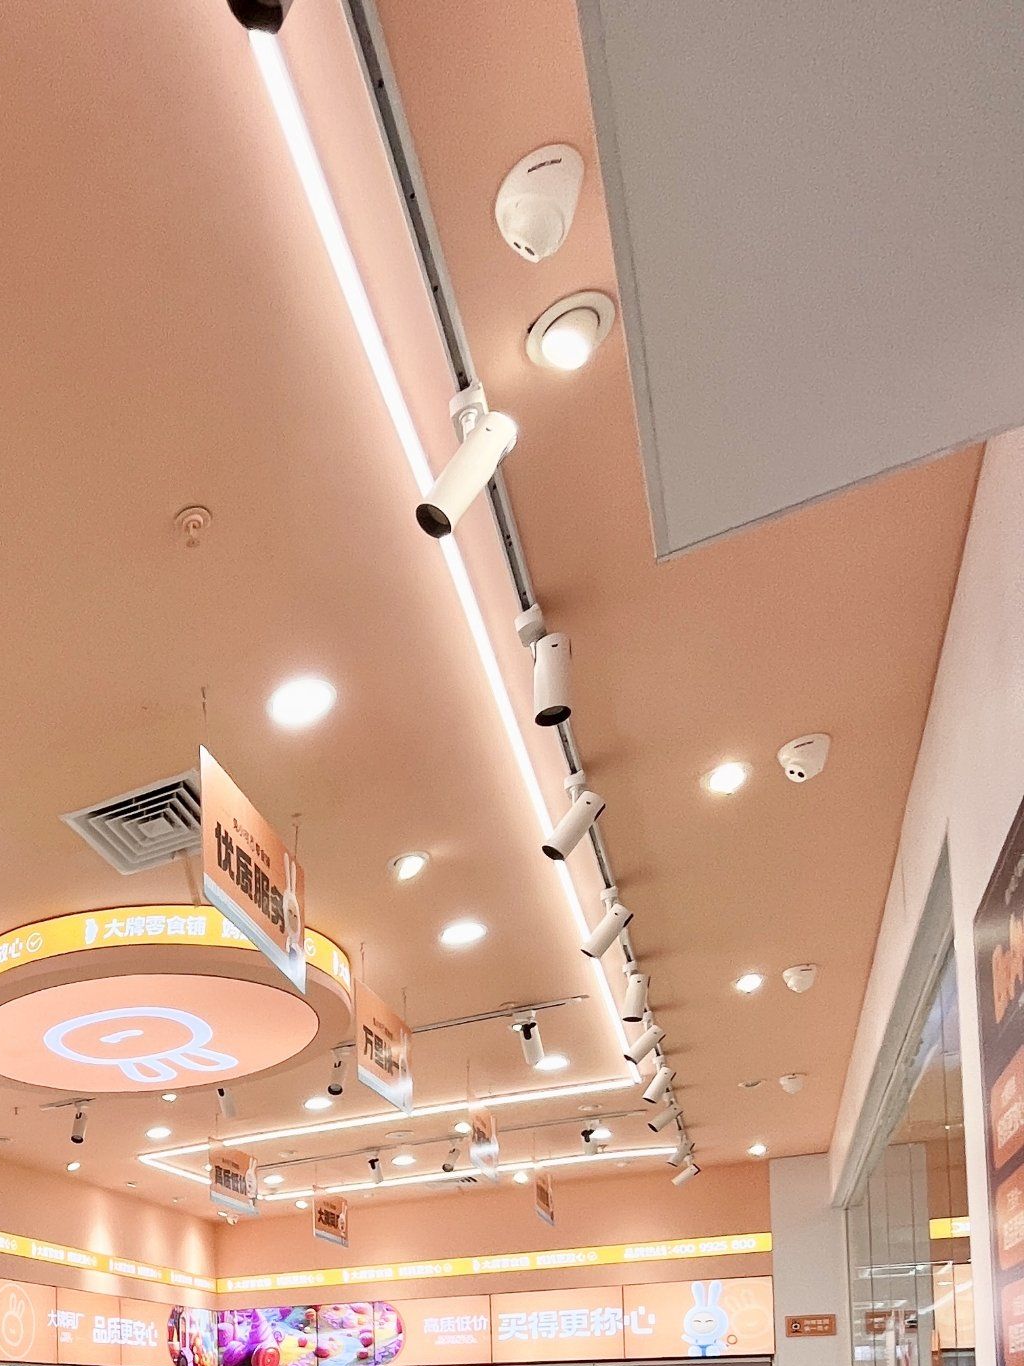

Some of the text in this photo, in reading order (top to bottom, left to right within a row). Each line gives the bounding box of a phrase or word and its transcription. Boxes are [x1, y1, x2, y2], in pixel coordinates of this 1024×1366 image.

[103, 915, 207, 939] 大牌零食铺
[93, 1315, 158, 1347] 品质更安心
[423, 1306, 656, 1341] 高质低价 买得更称心
